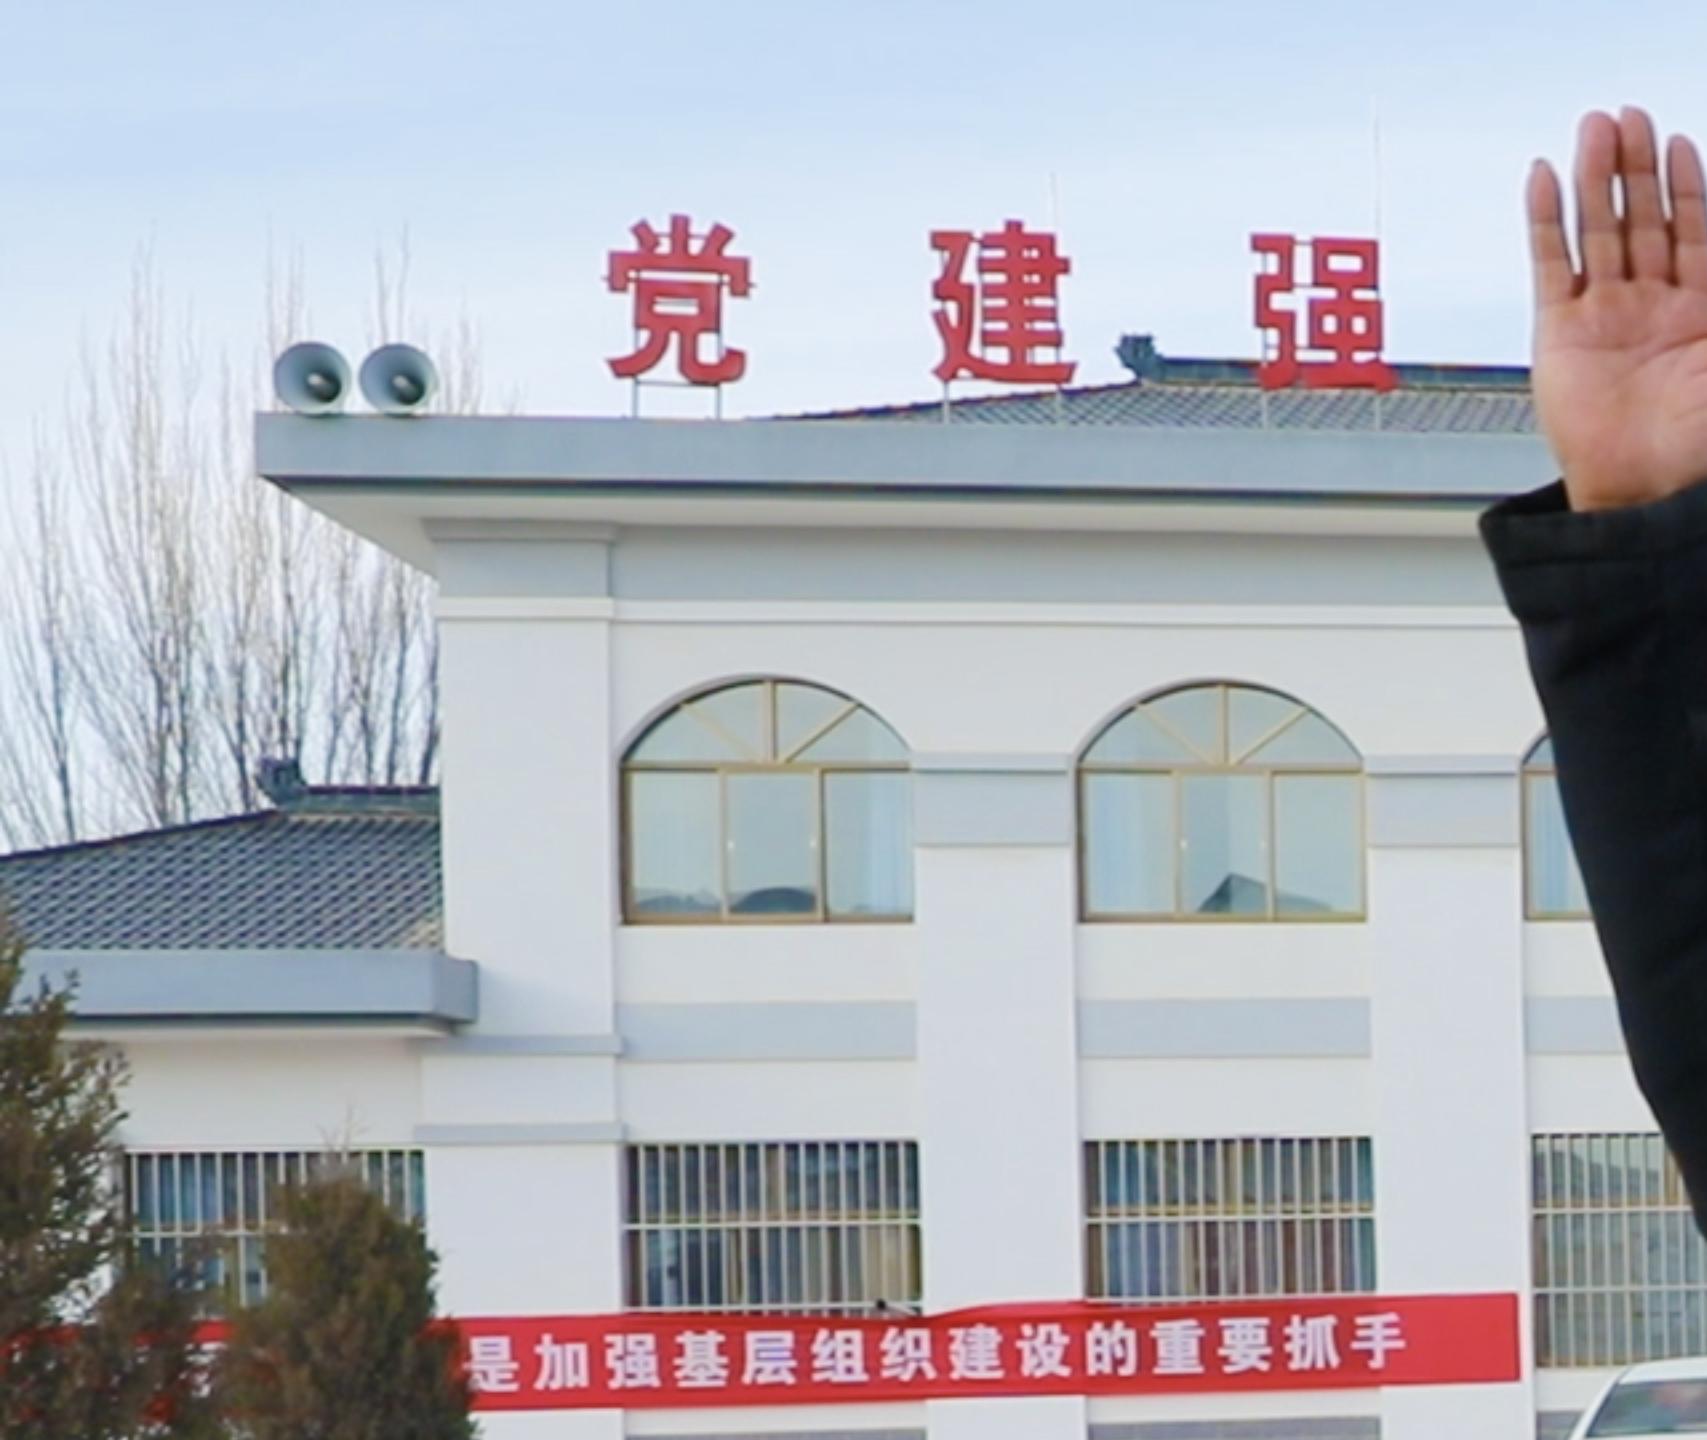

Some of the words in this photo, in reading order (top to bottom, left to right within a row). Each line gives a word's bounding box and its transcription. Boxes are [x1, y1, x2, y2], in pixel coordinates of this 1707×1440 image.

[607, 213, 1397, 390] 党建强
[464, 1311, 1408, 1393] 是加强基层组织建设的重要抓手
